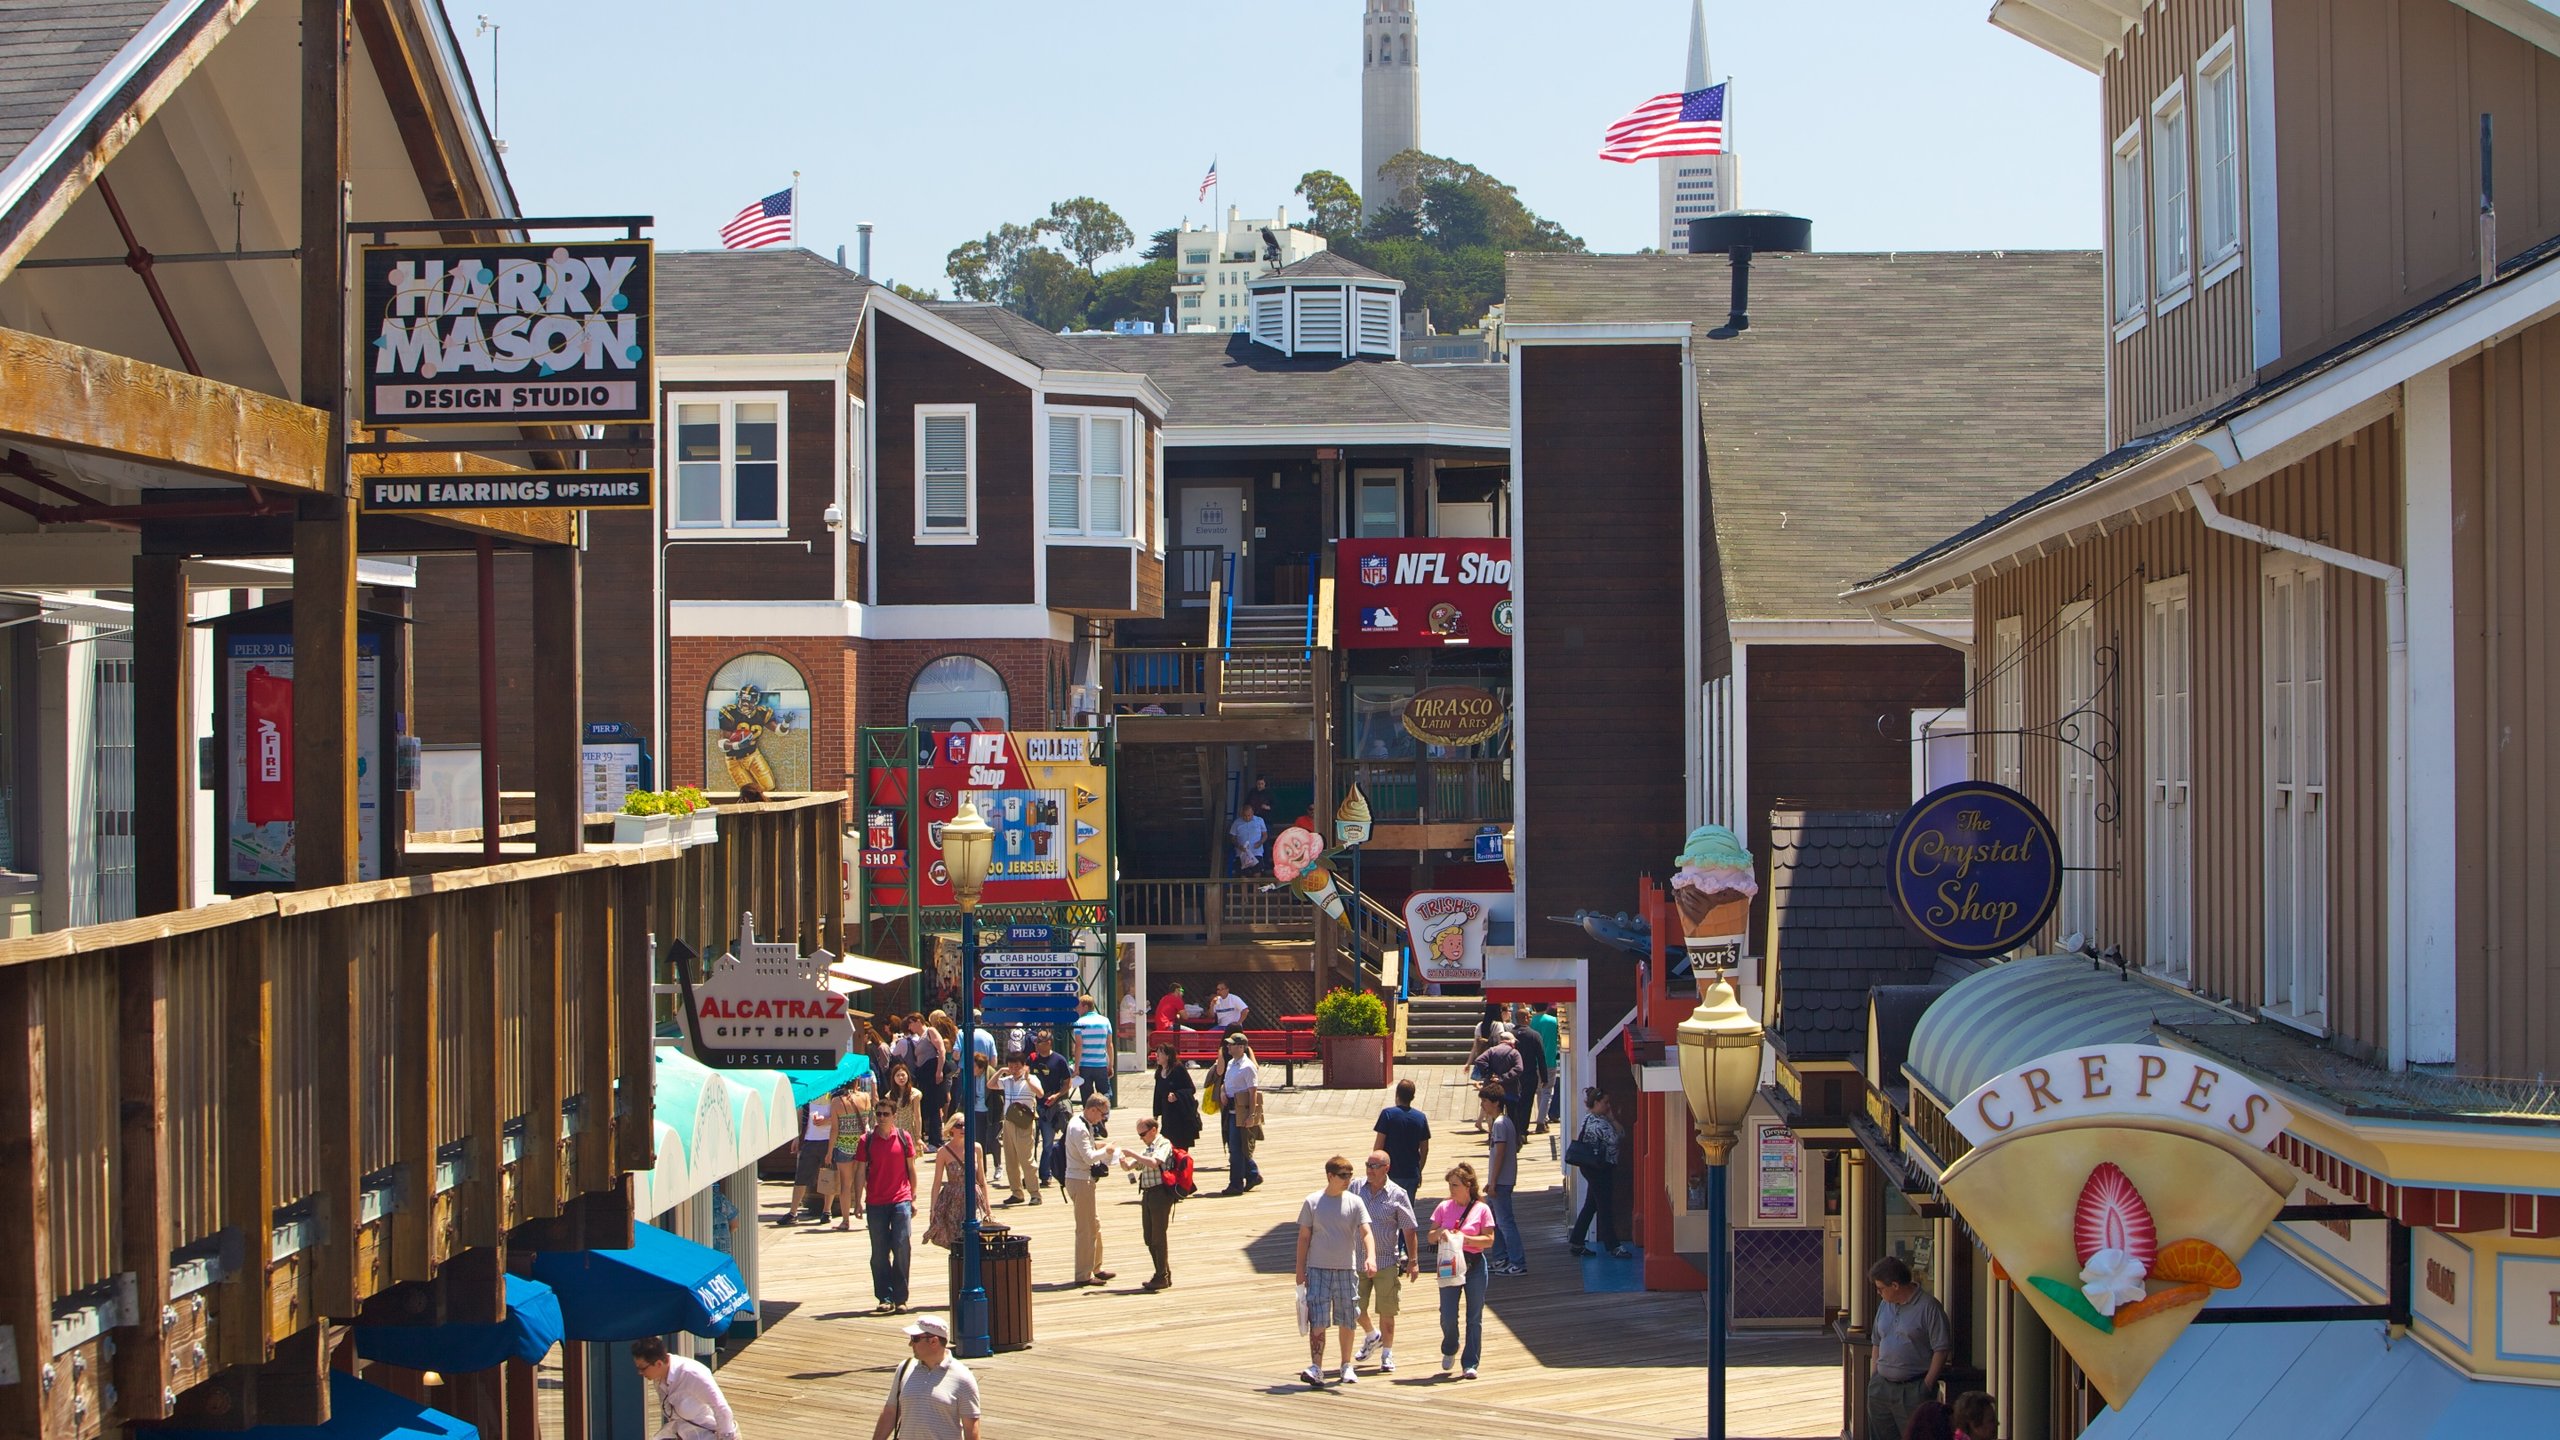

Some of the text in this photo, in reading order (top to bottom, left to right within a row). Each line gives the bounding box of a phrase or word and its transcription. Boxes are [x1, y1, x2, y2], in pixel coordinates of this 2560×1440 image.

[396, 256, 636, 316] HARRY
[376, 314, 636, 373] MASON
[405, 386, 610, 409] DESIGN STUDIO
[375, 481, 640, 503] FUN EARRINGS UPSTAIRS
[1195, 526, 1228, 534] Elevator
[1363, 568, 1387, 583] NFL
[1394, 553, 1449, 585] NFL
[235, 644, 261, 655] PIER
[262, 644, 274, 655] 39
[1414, 698, 1493, 717] TARASCO
[592, 725, 619, 733] PIER 39
[1421, 717, 1488, 729] LATIN ARTS
[266, 735, 277, 777] FIRE
[583, 752, 601, 760] PIER
[602, 752, 613, 761] 39
[968, 733, 1008, 764] NFL
[1028, 738, 1085, 762] COLLEGE
[968, 765, 1006, 789] Shop
[1956, 810, 1992, 832] The
[865, 853, 897, 865] SHOP
[1908, 826, 2036, 879] Crystal
[1008, 860, 1058, 875] JERSEYS!
[1416, 896, 1480, 920] TRISH'S
[1926, 879, 2017, 938] Shop
[1012, 928, 1048, 938] PIER 39
[1000, 954, 1058, 962] CRAB HOUSE
[994, 968, 1063, 977] LEVEL 2 SHOPS
[1003, 983, 1052, 992] BAY VIEWS
[700, 996, 845, 1019] ALCATRAZ
[717, 1026, 830, 1037] GIFT SHOP
[726, 1054, 820, 1065] UPSTAIRS
[1976, 1054, 2270, 1134] CREPES
